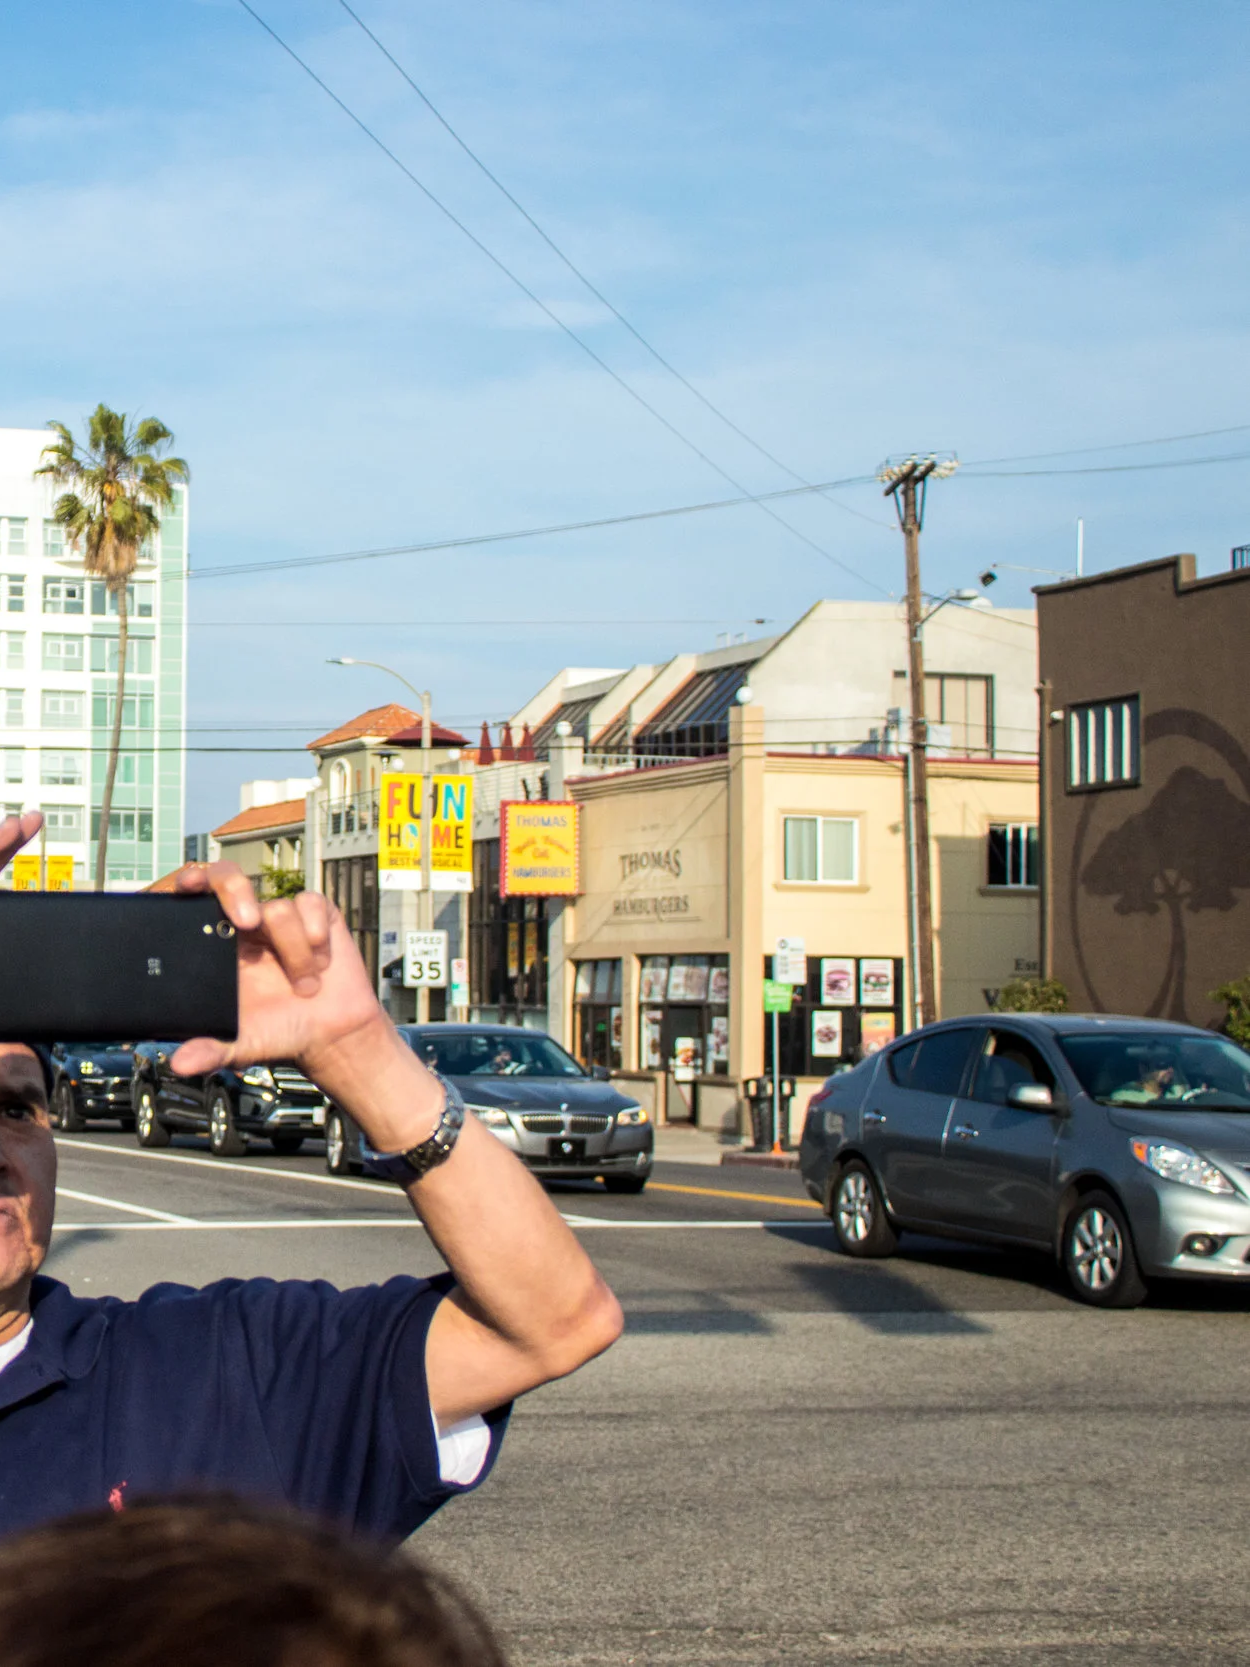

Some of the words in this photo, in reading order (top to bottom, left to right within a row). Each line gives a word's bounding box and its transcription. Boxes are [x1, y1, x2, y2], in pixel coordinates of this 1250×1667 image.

[387, 782, 465, 820] FUN
[517, 815, 568, 827] THOMAS
[388, 823, 464, 849] HOME
[513, 867, 572, 878] HAMBURGERS
[618, 849, 682, 880] THOMAS
[613, 895, 689, 921] HAMBURGERS
[410, 936, 442, 944] SPEED
[412, 949, 438, 957] LIMIT
[411, 961, 441, 980] 35
